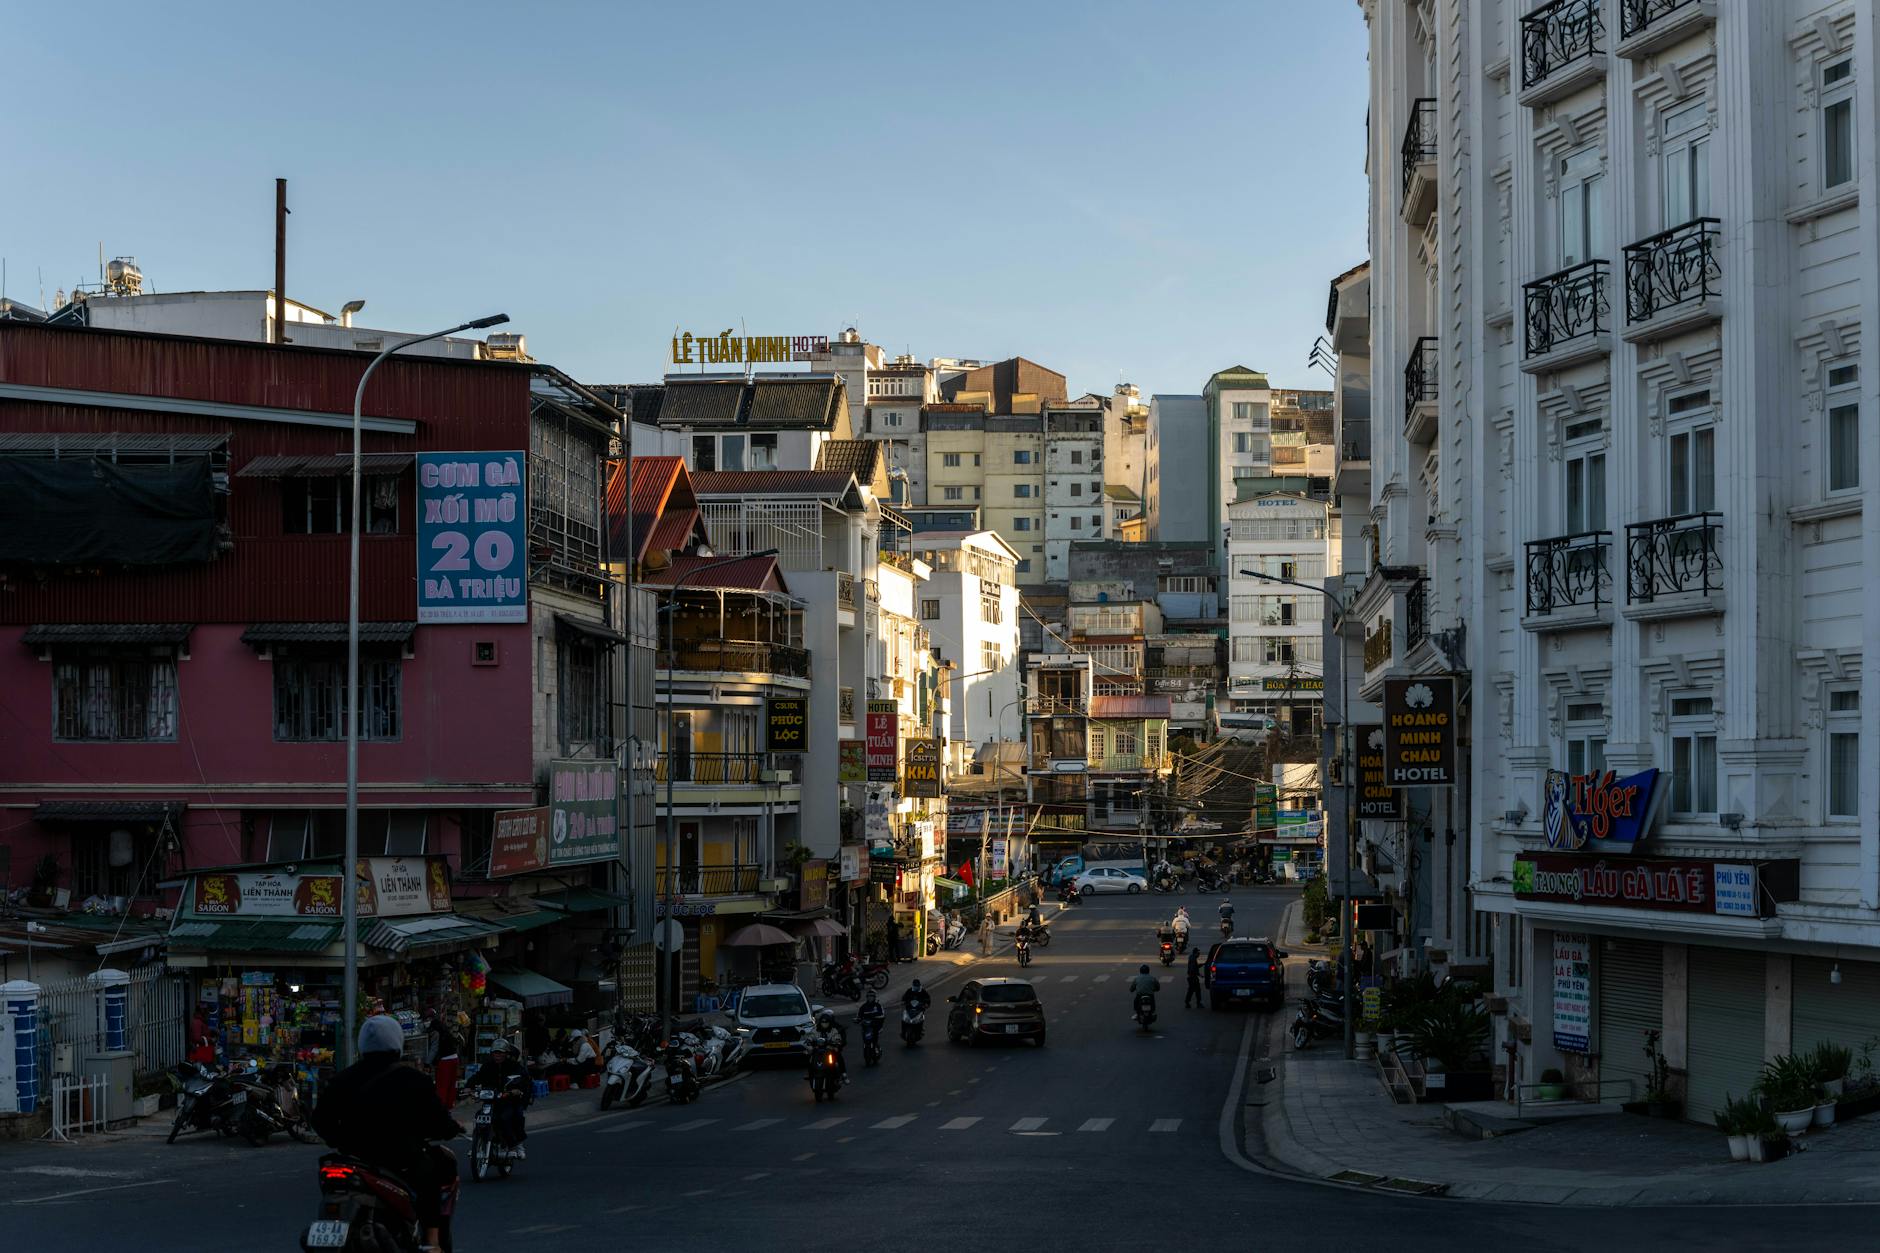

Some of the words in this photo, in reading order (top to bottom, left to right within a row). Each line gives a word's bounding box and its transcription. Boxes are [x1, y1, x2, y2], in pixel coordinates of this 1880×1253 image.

[672, 331, 693, 363] LÊ
[696, 328, 743, 363] TUẤN
[746, 337, 790, 363] MINH
[793, 336, 831, 352] HOTEL
[421, 462, 480, 488] CƠM
[484, 457, 520, 487] GÀ
[424, 493, 469, 524] XỐI
[474, 492, 516, 522] MỠ
[1257, 499, 1297, 507] HOTEL
[430, 531, 515, 571] 20
[424, 575, 454, 599] BÀ
[459, 575, 520, 603] TRIỆU
[868, 703, 894, 712] HOTEL
[771, 713, 803, 725] PHÚC
[875, 714, 887, 729] LÊ
[774, 728, 799, 742] LỘC
[868, 731, 894, 748] TUẤN
[1400, 732, 1440, 744] MINH
[867, 754, 894, 766] MINH
[1360, 752, 1384, 767] HOÀ
[1400, 747, 1440, 763] CHÂU
[1364, 771, 1384, 783] MIN
[1393, 768, 1448, 780] HOTEL
[1361, 802, 1397, 814] HOTEL
[1572, 769, 1637, 838] Tiger
[569, 812, 585, 839] 20
[380, 873, 397, 893] LIÊN
[397, 872, 421, 892] THÀNH
[1535, 871, 1556, 893] TAO
[1557, 867, 1581, 900] NGỘ
[1583, 860, 1617, 897] LẨU
[1623, 864, 1650, 899] GÀ
[1655, 867, 1681, 902] LÁ
[1734, 870, 1750, 886] YÊN
[243, 888, 261, 897] LIÊN
[264, 887, 293, 897] THÀNH
